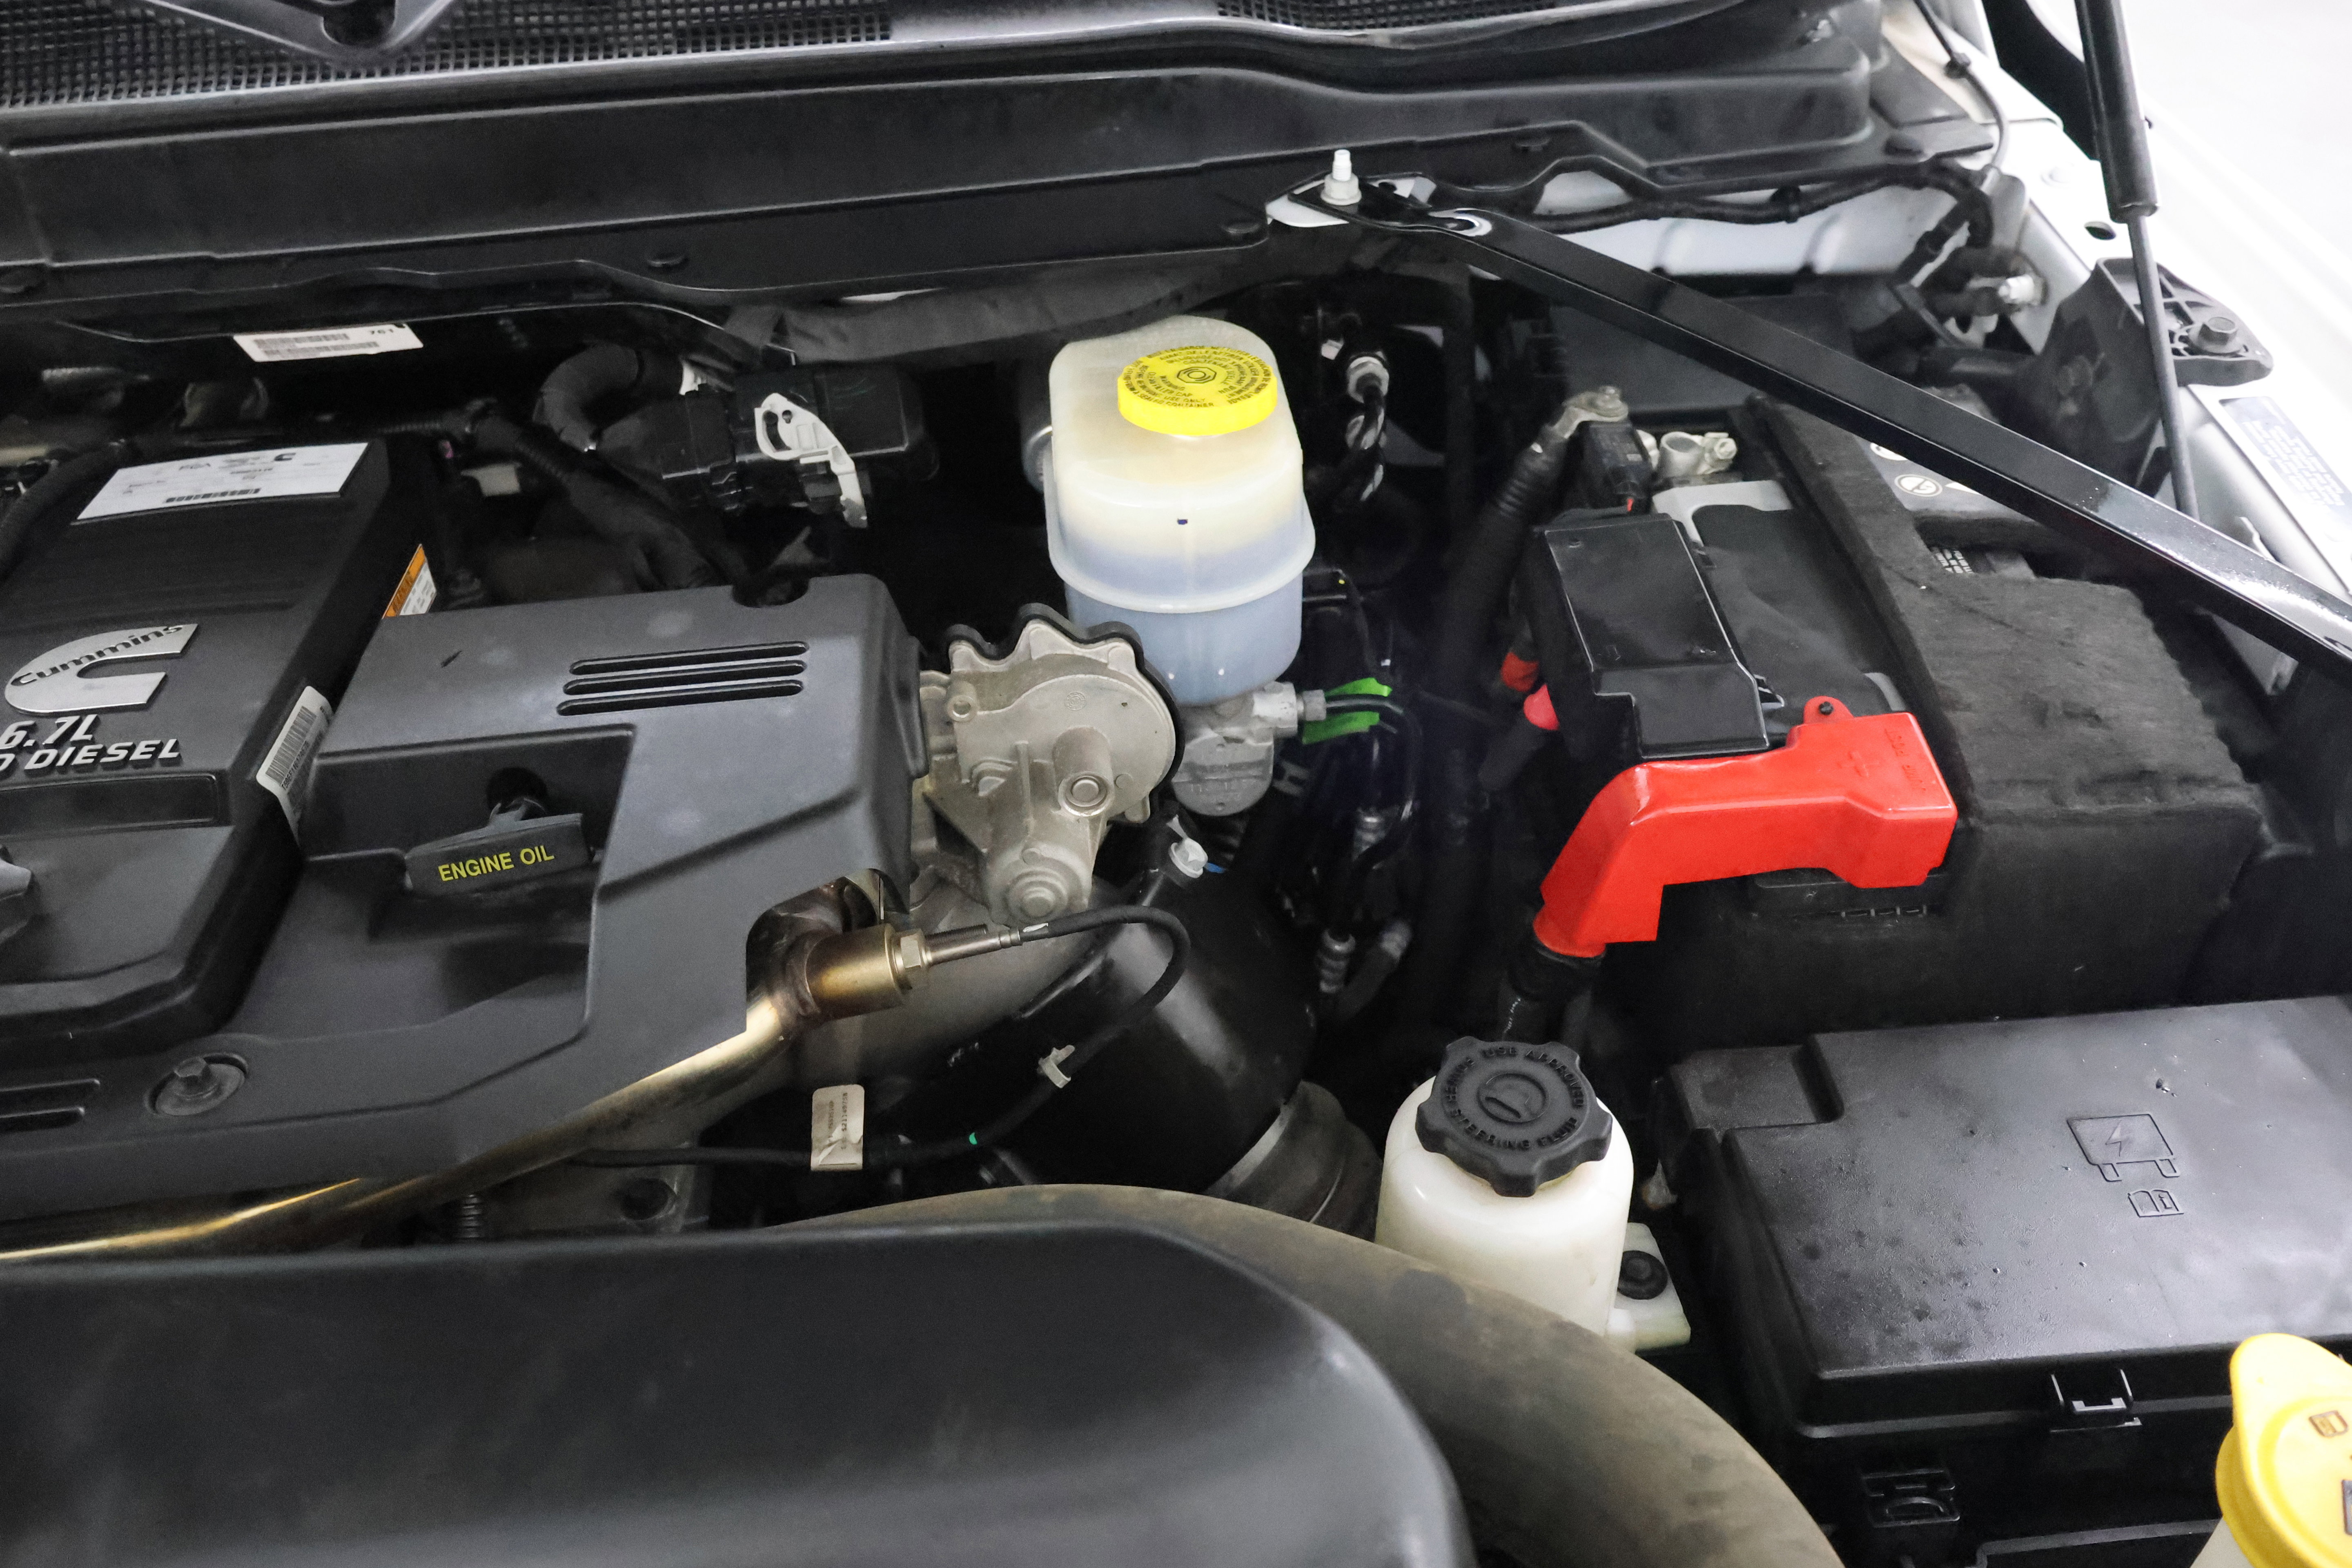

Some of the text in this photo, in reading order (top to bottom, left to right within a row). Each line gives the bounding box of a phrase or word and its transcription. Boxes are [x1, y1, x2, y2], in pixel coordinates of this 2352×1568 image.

[11, 625, 183, 686] Cummins
[0, 714, 98, 750] 6.7L
[24, 738, 180, 770] DIESEL
[438, 845, 555, 882] ENGINE OIL
